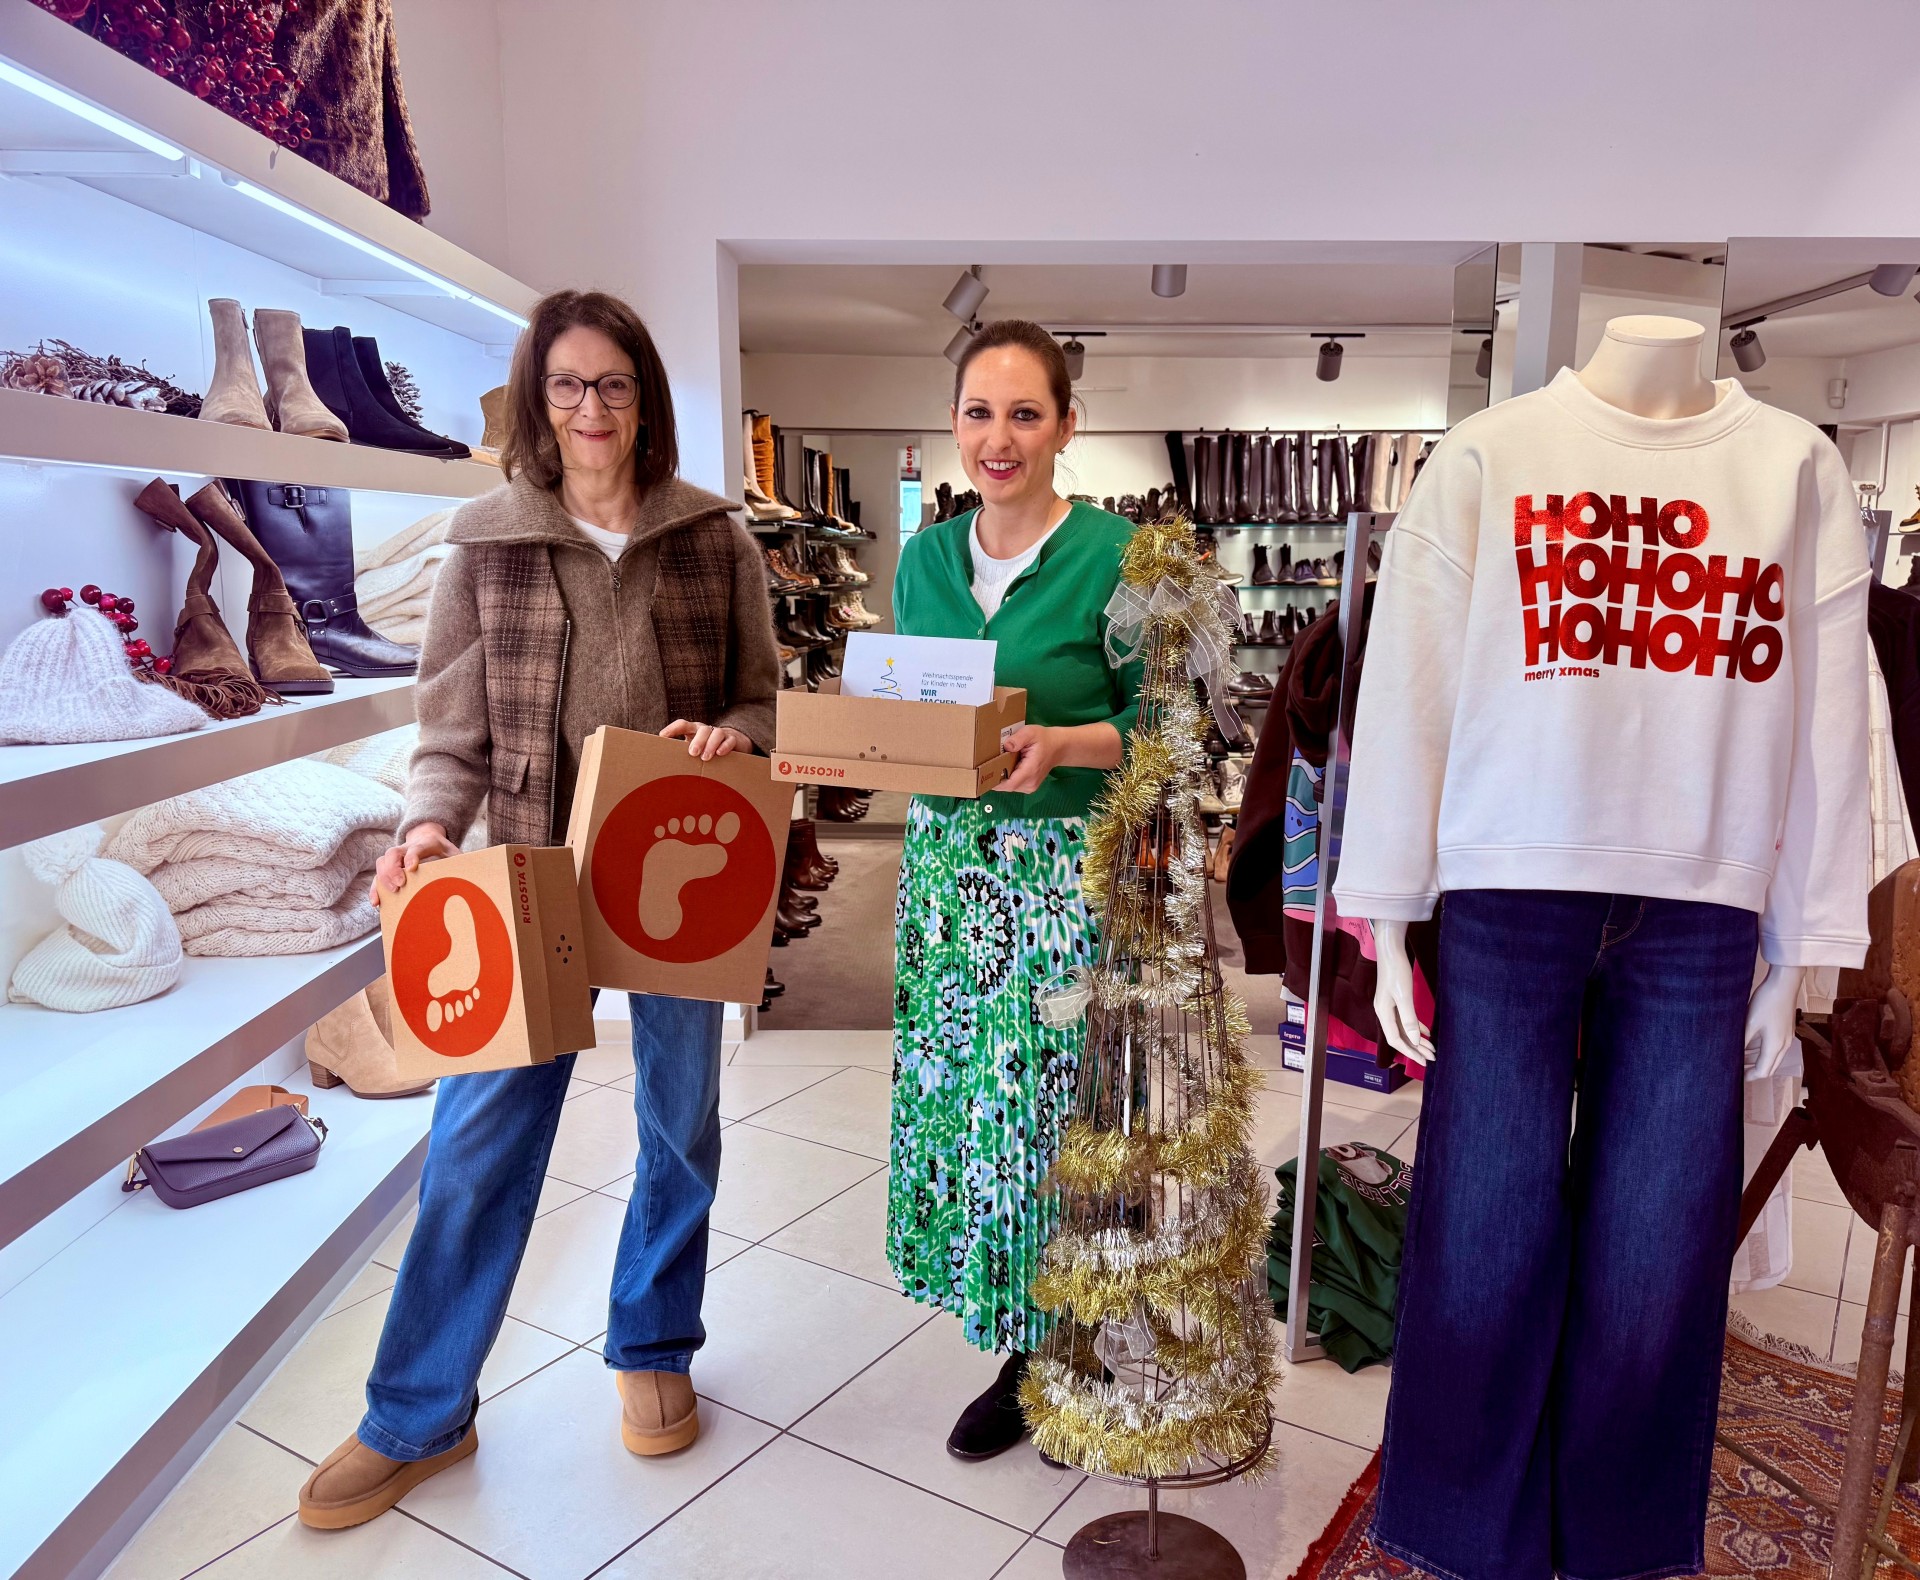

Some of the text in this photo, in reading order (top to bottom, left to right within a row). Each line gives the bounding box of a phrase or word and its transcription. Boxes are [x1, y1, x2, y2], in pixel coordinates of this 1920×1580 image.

[1514, 491, 1710, 549] HOHO
[1515, 542, 1785, 622] HOHOHO
[1522, 602, 1783, 683] HOHOHO
[922, 672, 974, 681] Weihnachtsspende
[1524, 666, 1600, 682] merry xmas
[920, 689, 937, 697] WIR
[795, 764, 845, 778] RICOSTA
[518, 872, 531, 924] RICOSTA
